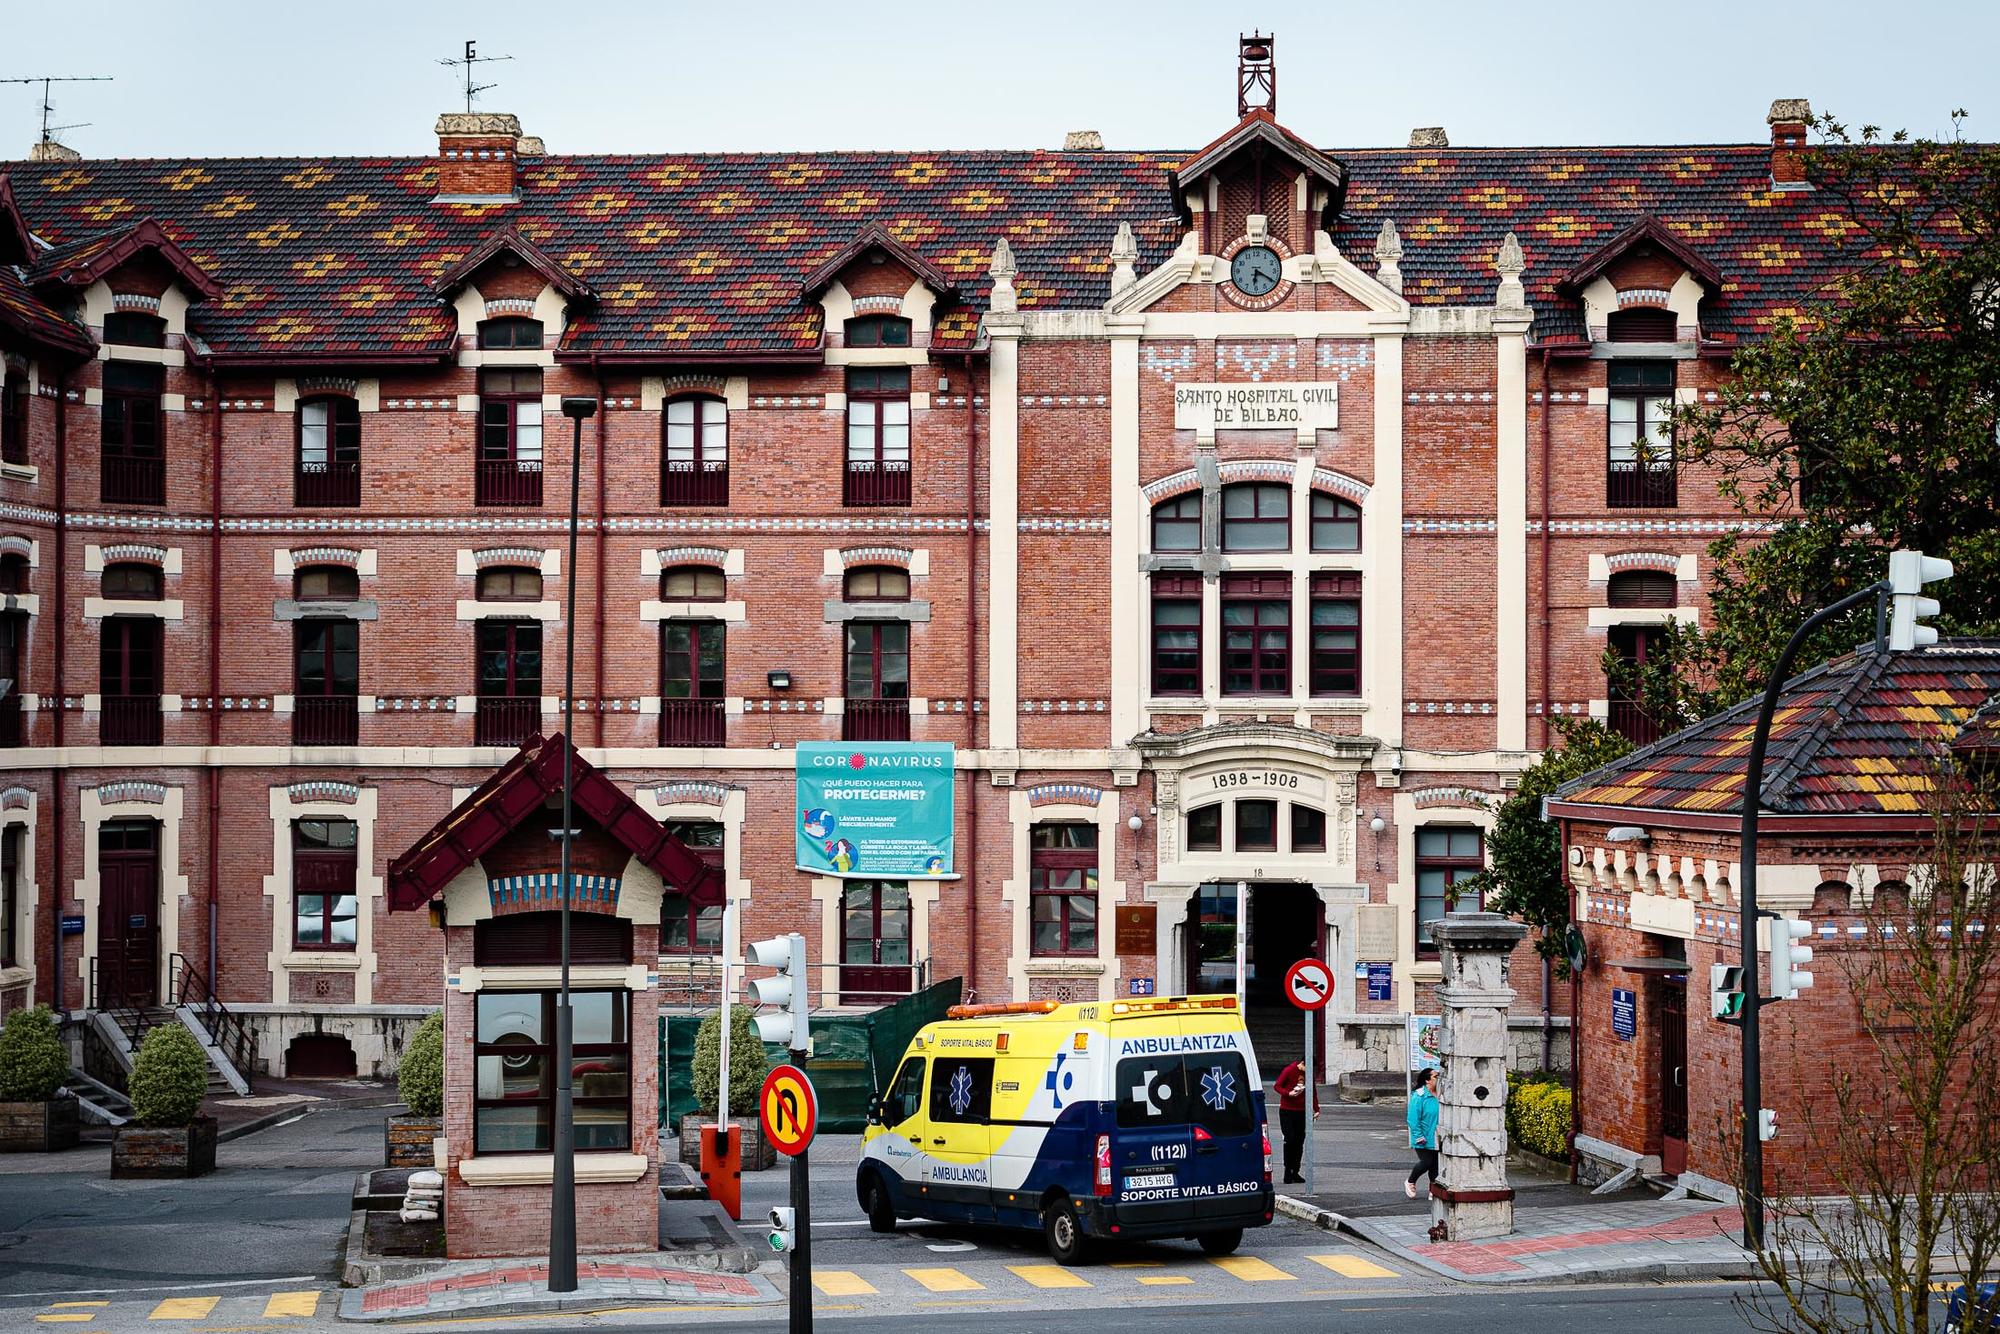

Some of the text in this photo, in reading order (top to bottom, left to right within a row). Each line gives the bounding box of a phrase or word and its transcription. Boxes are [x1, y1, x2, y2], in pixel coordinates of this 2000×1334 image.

[1175, 388, 1337, 404] SANTO HOSPITAL CIVIL
[1214, 408, 1234, 423] DE
[822, 779, 843, 788] ¿QUÉ
[901, 780, 923, 788] PARA
[824, 789, 926, 801] PROTEGERME?
[824, 840, 833, 851] 2
[1254, 868, 1264, 878] 18
[1121, 1034, 1238, 1055] ANBULANTZIA
[932, 1165, 988, 1184] AMBULANCIA
[1131, 1176, 1154, 1187] 3215
[1120, 1181, 1259, 1202] SOPORTE VITAL BÁSICO
